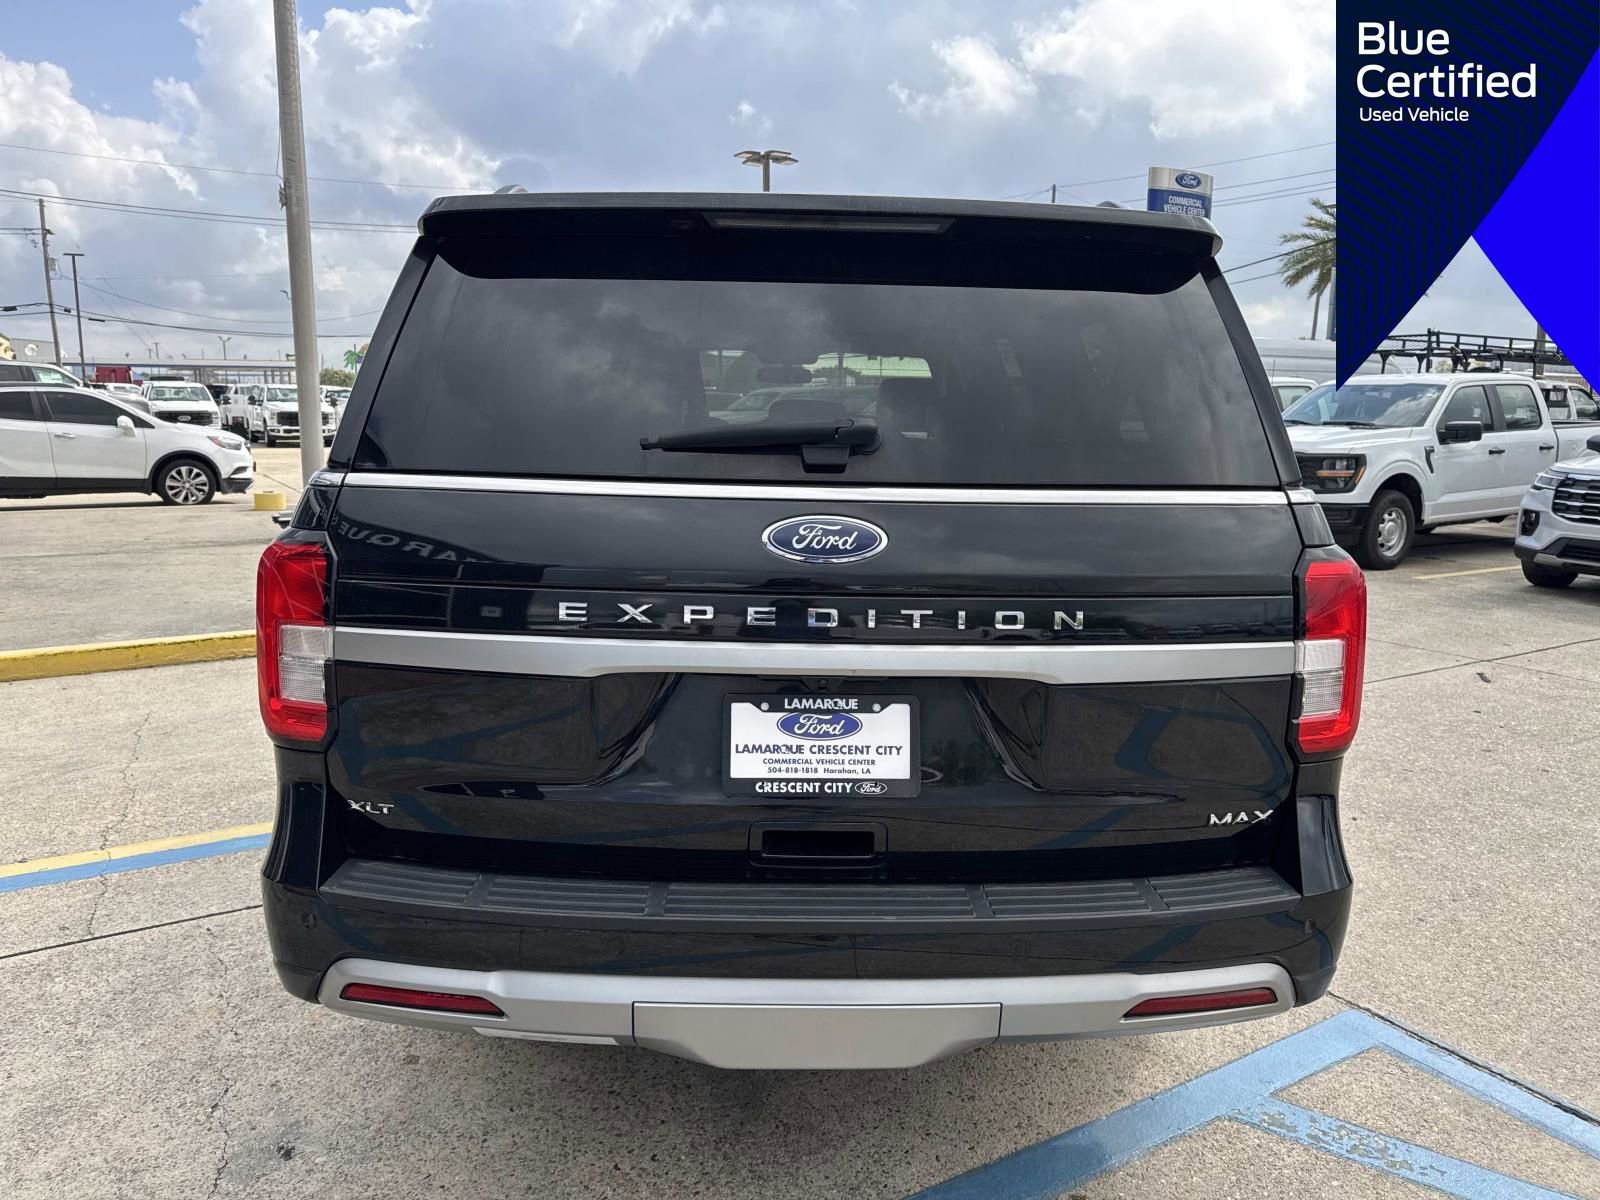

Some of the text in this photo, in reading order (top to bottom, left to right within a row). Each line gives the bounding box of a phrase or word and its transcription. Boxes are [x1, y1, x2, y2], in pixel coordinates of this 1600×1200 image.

[1168, 195, 1203, 208] COMMERCIAL
[1163, 203, 1206, 217] VEHICLE CENTER
[792, 523, 858, 550] Ford
[558, 601, 1084, 631] EXPEDITION
[784, 698, 858, 710] LAMARQUE
[794, 713, 844, 735] Ford
[735, 743, 903, 756] LAMARQUE CRESCENT CITY
[815, 758, 846, 766] VEHICLE
[767, 766, 871, 775] 504-818-1818 Harahan, LA
[755, 781, 821, 793] CRESCENT
[824, 782, 853, 793] CITY
[347, 799, 395, 815] XLT
[1209, 809, 1274, 826] MAX
